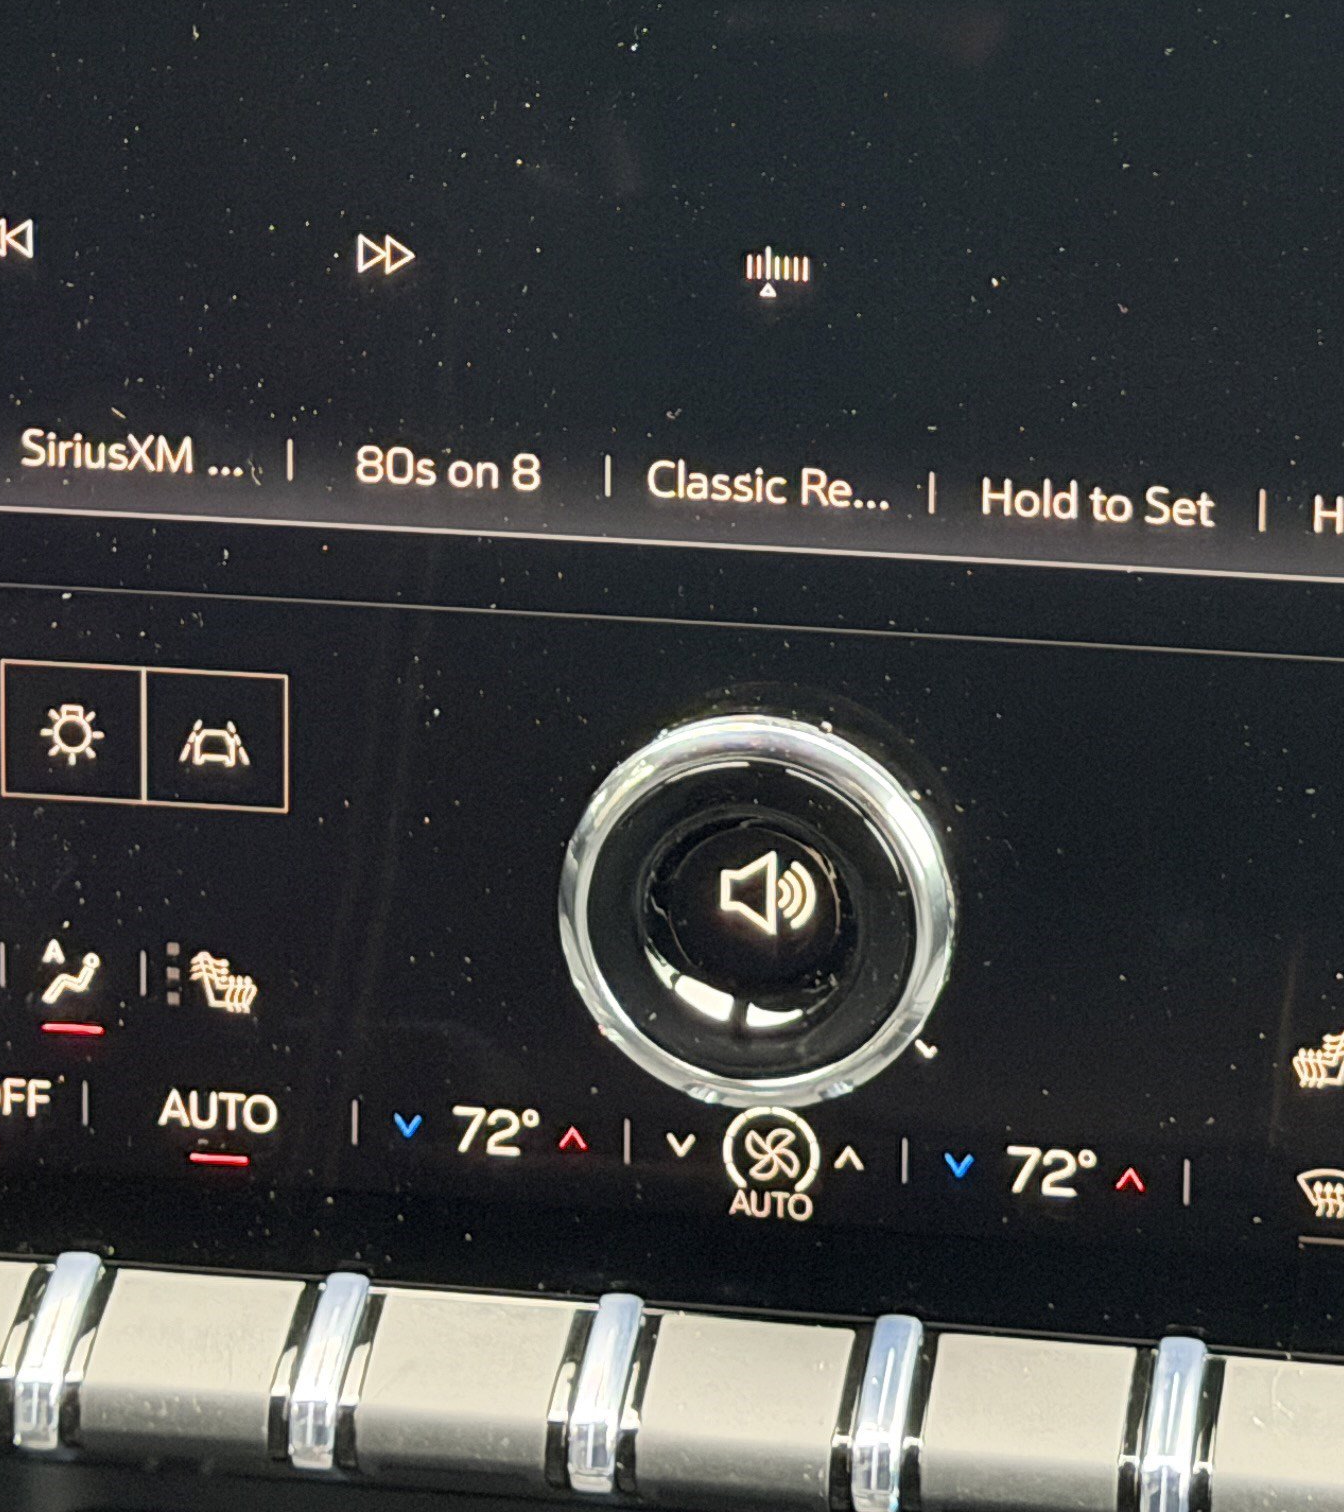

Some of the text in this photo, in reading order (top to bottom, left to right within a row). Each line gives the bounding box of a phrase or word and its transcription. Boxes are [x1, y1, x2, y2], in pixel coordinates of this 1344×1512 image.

[20, 427, 195, 476] SiriusXM
[354, 444, 542, 493] 80s on 8
[646, 457, 789, 506] Classic
[981, 475, 1217, 529] Hold to Set
[41, 938, 65, 966] A
[156, 1088, 279, 1135] AUTO
[451, 1104, 541, 1158] 72°
[1005, 1144, 1098, 1199] 72°
[727, 1190, 814, 1222] AUTO
